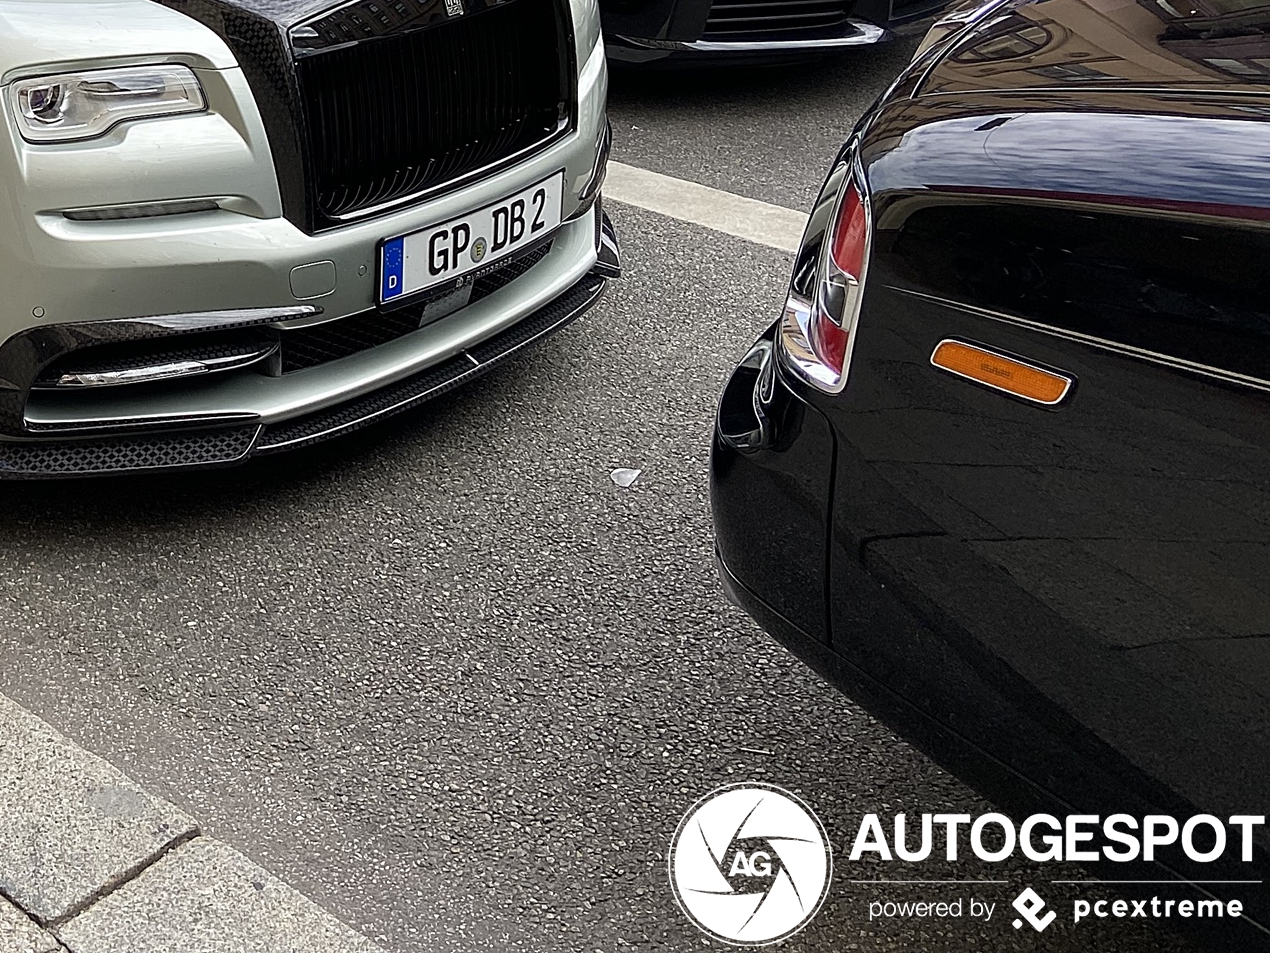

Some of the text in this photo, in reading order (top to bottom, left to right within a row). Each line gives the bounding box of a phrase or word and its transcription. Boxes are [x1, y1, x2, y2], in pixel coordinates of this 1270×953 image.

[428, 222, 470, 276] GP
[491, 199, 525, 253] DB
[531, 188, 545, 234] 2
